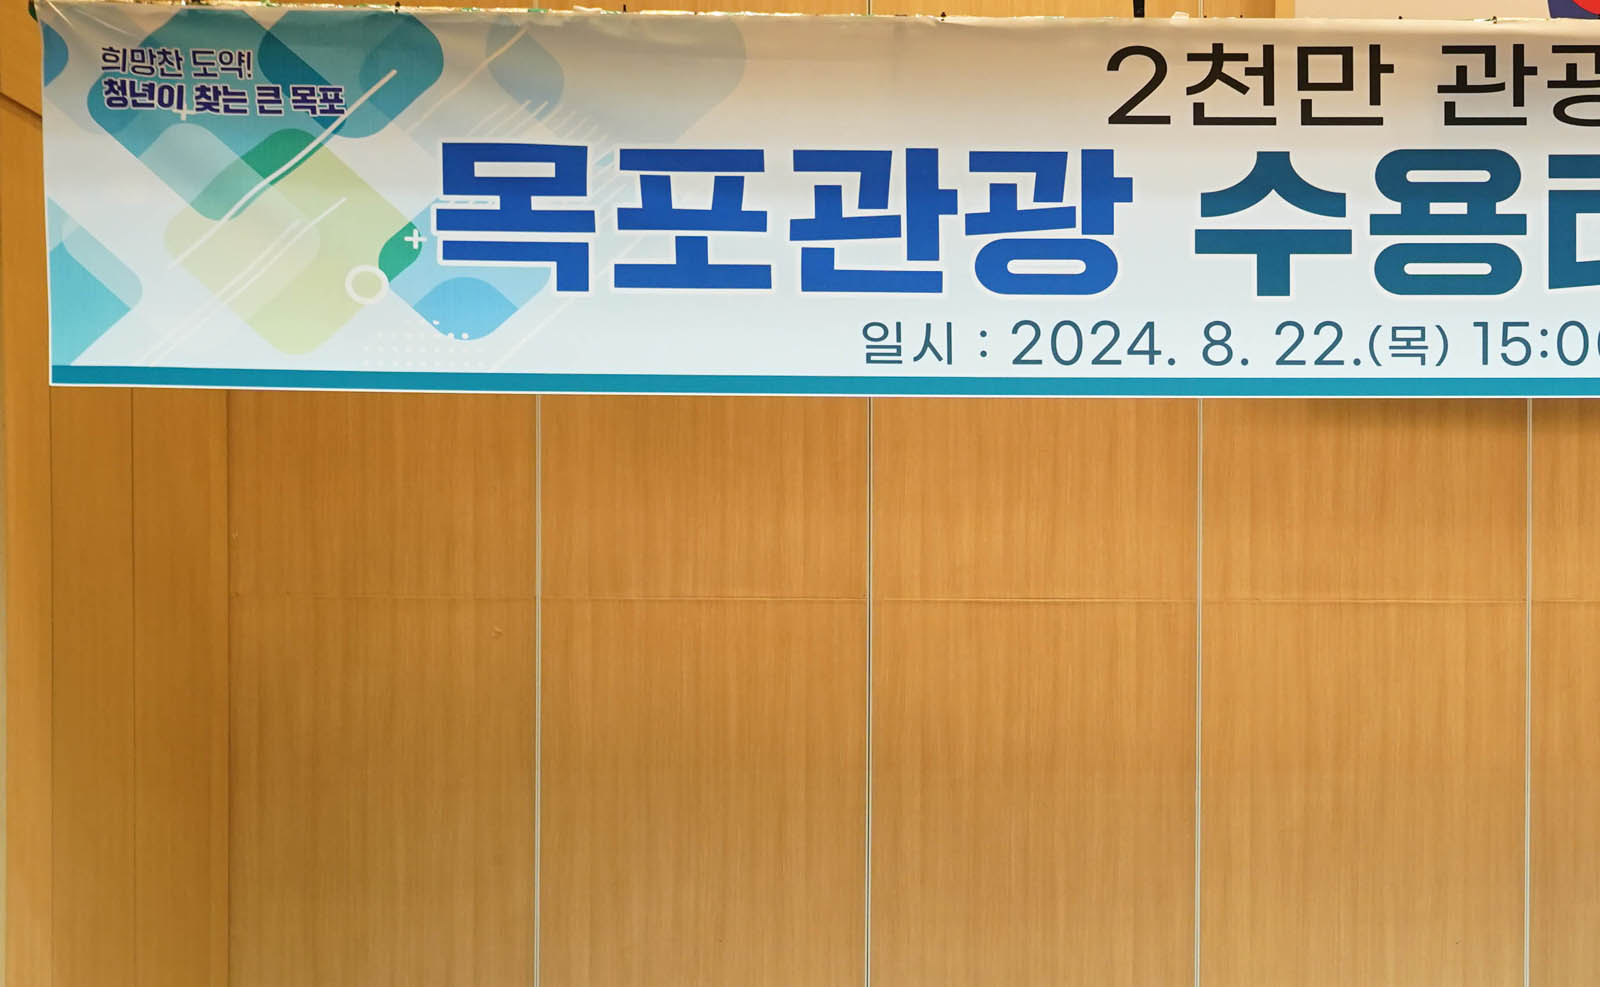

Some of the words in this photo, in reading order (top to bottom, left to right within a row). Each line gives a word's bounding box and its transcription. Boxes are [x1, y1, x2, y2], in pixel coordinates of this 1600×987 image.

[100, 46, 186, 79] 희망찬
[191, 48, 252, 79] 도약!
[1106, 42, 1395, 126] 2천만
[103, 78, 185, 112] 청년이
[194, 84, 249, 115] 찾는
[256, 86, 284, 115] 큰
[290, 86, 346, 116] 목포
[434, 142, 1134, 296] 목포관광
[1011, 319, 1176, 366] 2024.
[1202, 320, 1249, 367] 8.
[1274, 320, 1449, 367] 22.(목)
